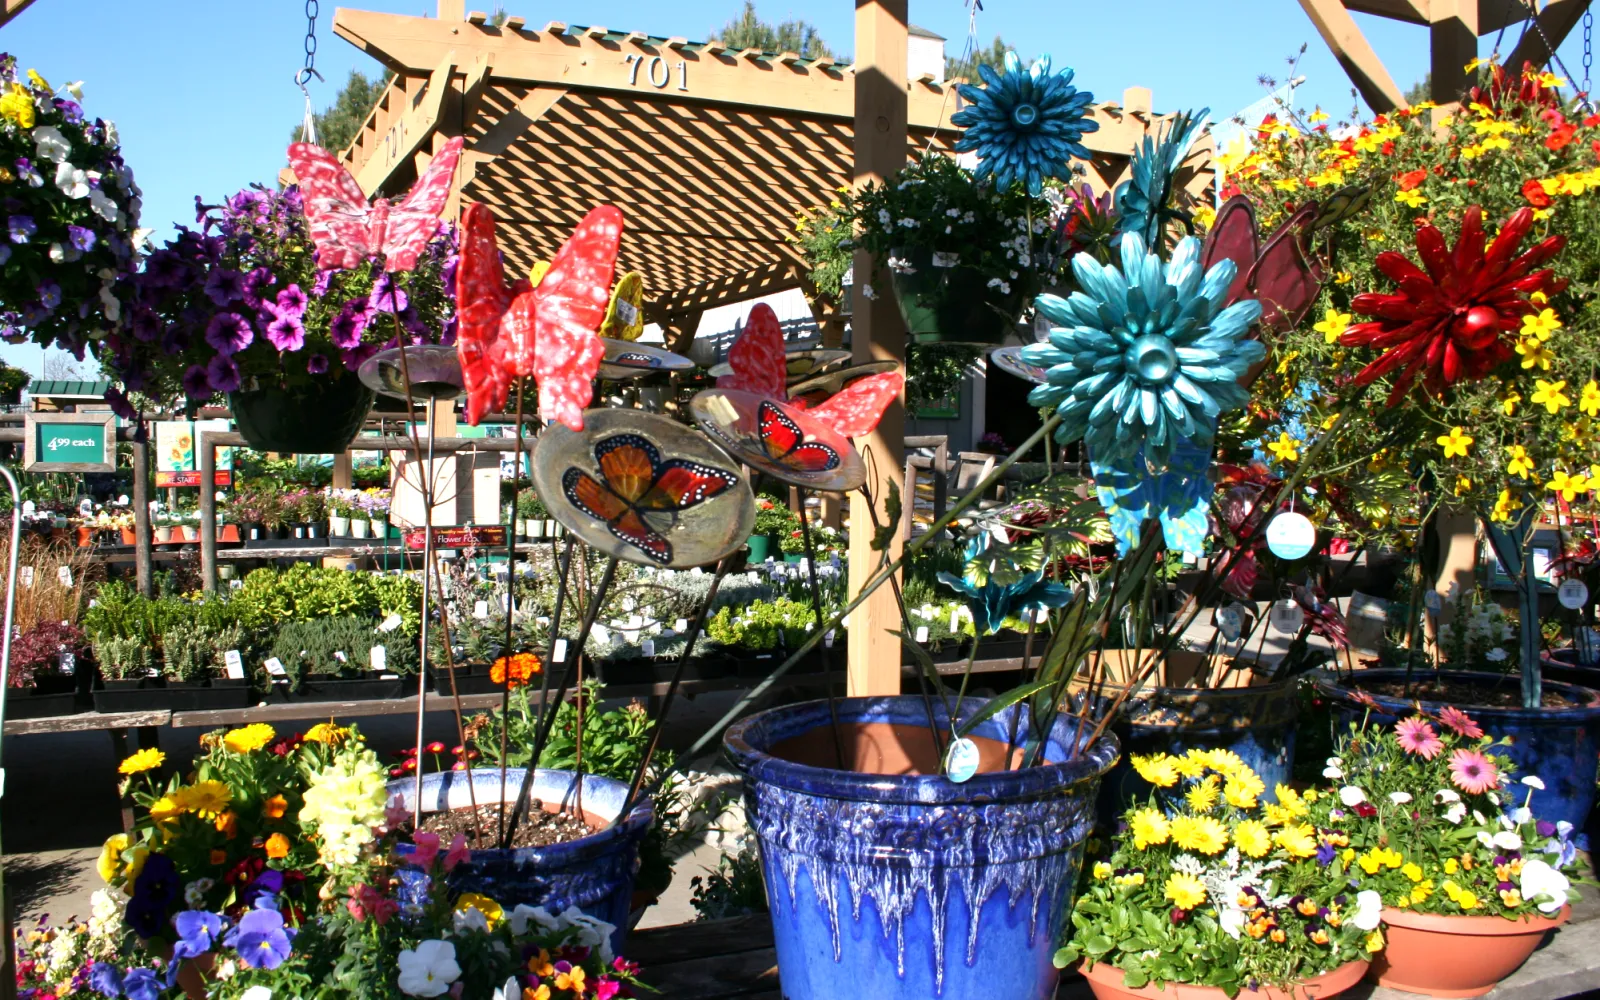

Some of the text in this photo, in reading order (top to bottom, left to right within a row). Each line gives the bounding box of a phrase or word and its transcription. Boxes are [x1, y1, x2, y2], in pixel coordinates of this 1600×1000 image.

[624, 54, 688, 92] 701
[385, 117, 404, 167] 701
[72, 438, 95, 447] each
[437, 534, 461, 543] Flower
